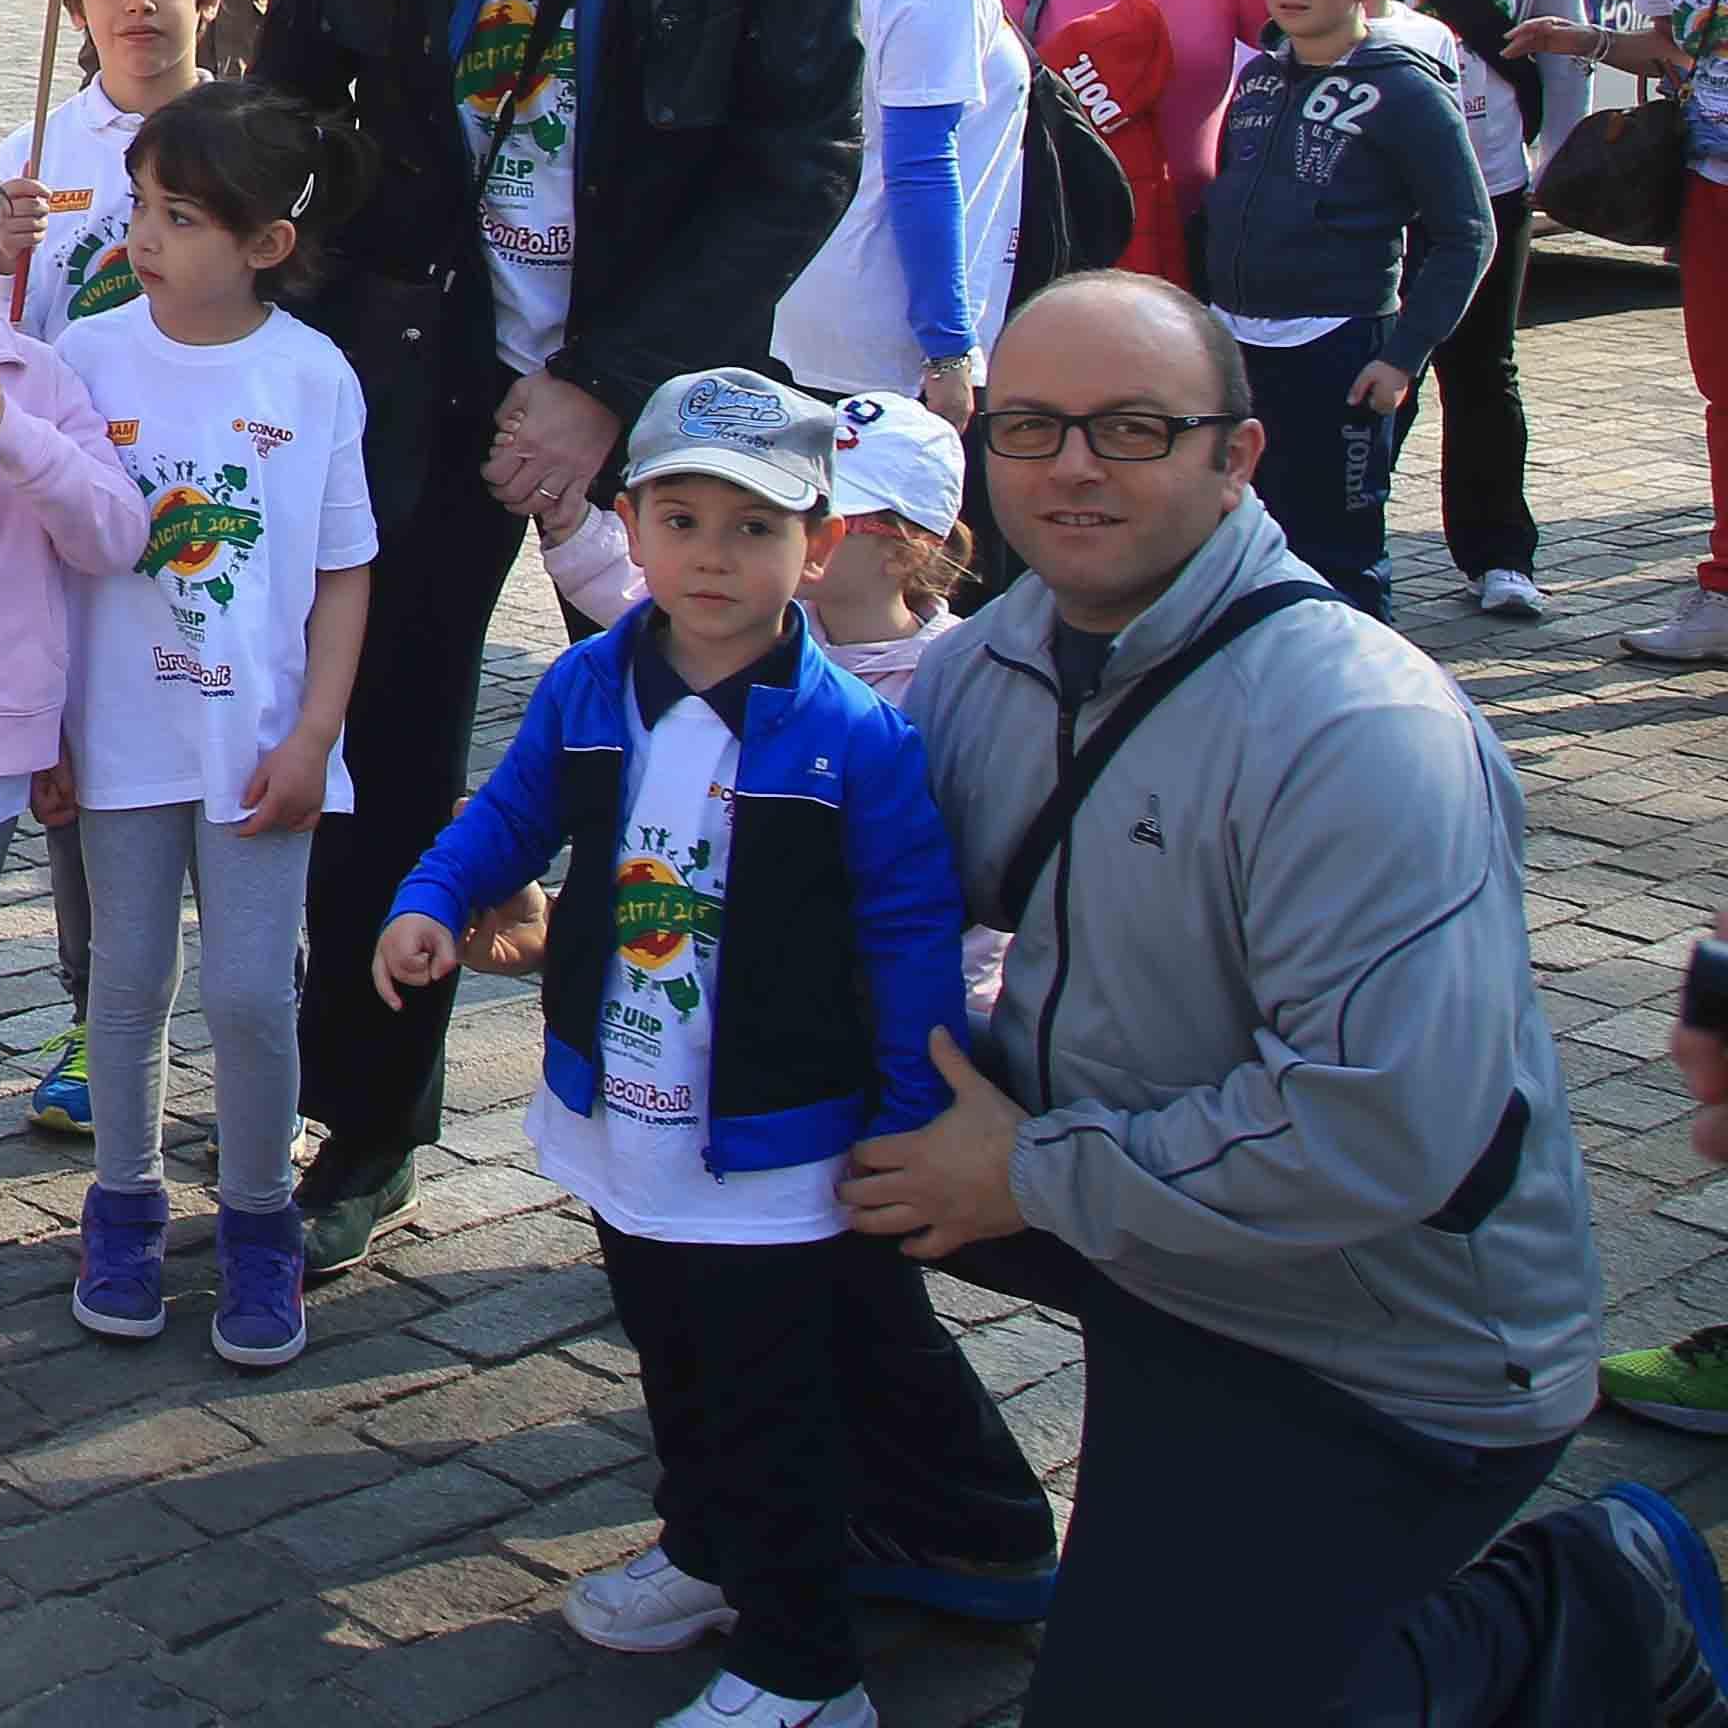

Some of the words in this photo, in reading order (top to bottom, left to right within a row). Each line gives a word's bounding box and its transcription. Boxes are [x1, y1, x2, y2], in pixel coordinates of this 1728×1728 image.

[1302, 76, 1381, 135] 62
[495, 155, 534, 179] ISP
[51, 191, 89, 204] CAAM
[247, 422, 294, 442] CONAD
[207, 518, 249, 534] 2015
